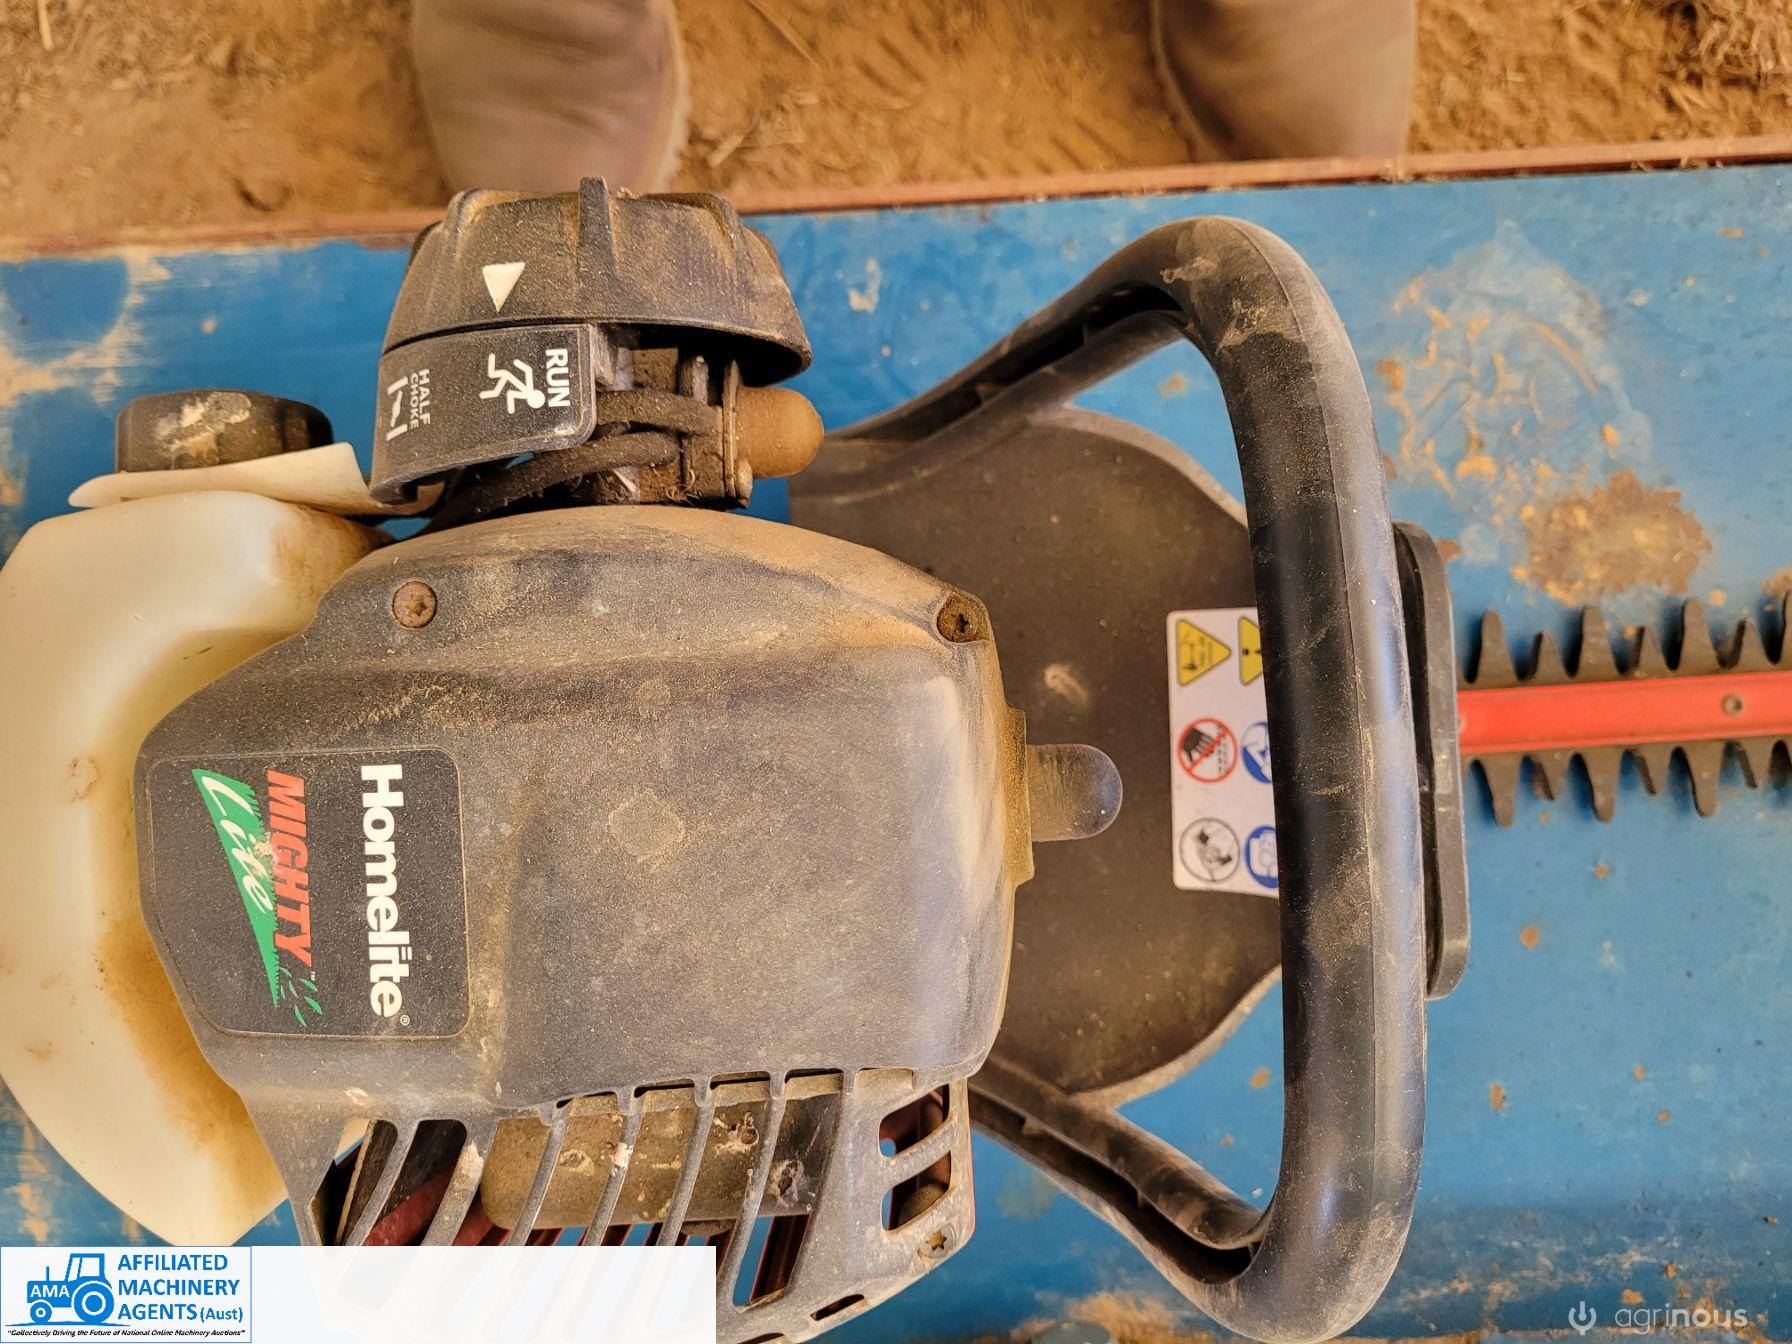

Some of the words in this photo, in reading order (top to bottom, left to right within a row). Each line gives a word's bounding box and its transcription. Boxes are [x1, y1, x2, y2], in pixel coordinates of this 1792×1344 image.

[409, 372, 420, 430] CHOKE
[418, 368, 431, 425] HALF
[545, 348, 571, 408] RUN
